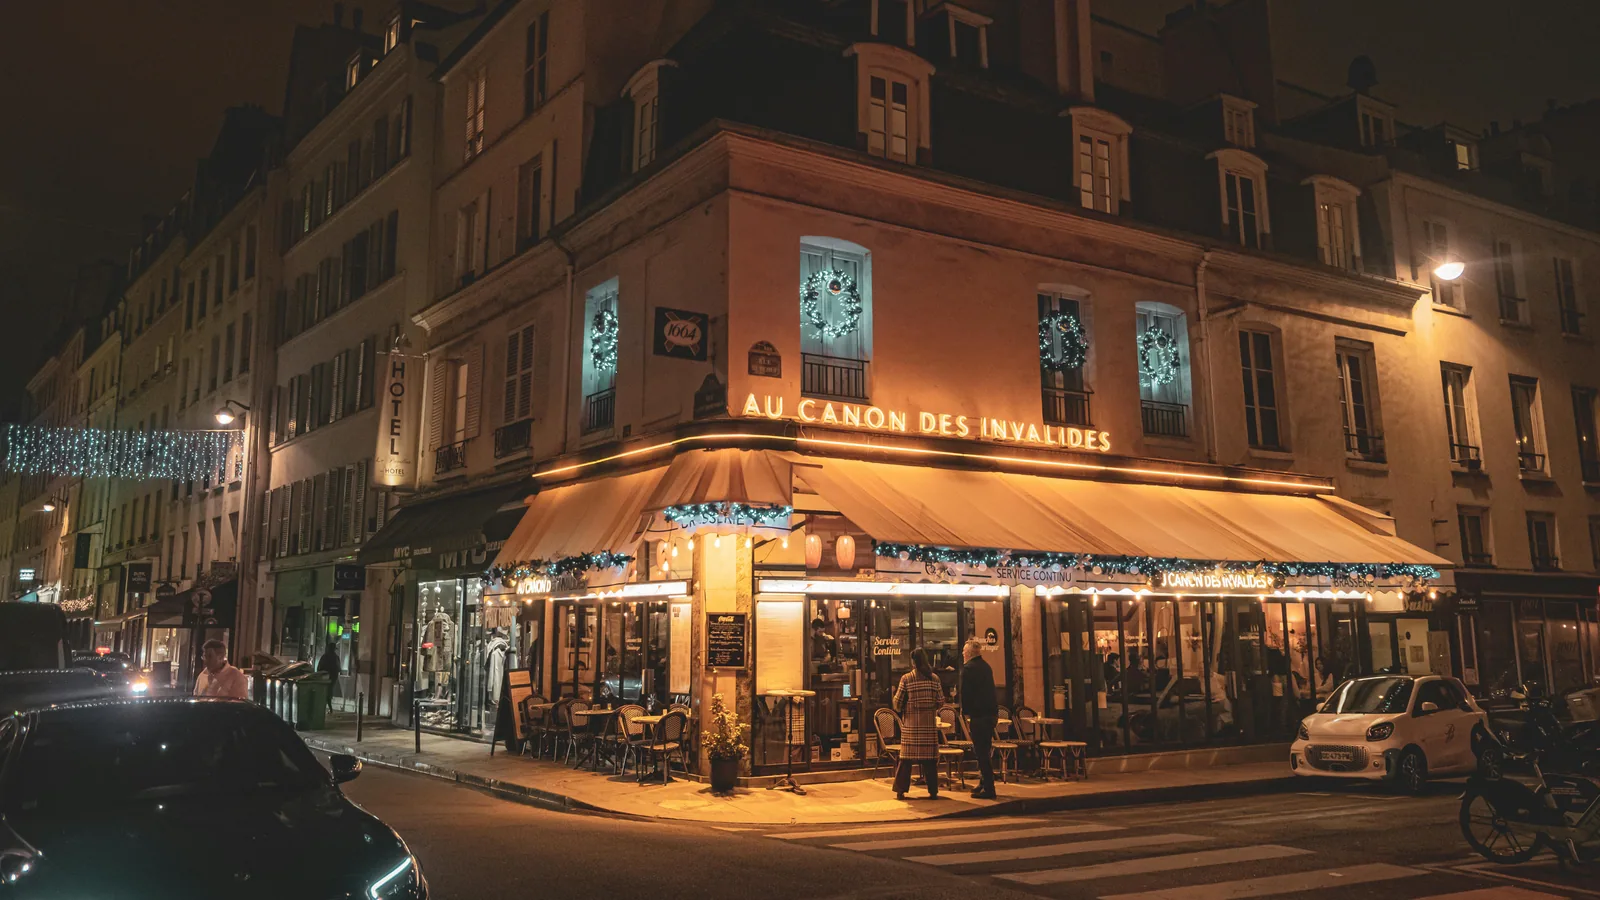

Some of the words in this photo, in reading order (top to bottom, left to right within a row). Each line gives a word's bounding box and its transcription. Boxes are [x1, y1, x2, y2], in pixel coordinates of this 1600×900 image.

[667, 323, 698, 341] 1664
[389, 360, 406, 456] HOTEL
[742, 393, 783, 420] AU
[798, 399, 906, 432] CANON
[920, 411, 969, 437] DES
[981, 416, 1111, 452] INVALIDES
[681, 514, 746, 529] BRSSERIE
[393, 546, 411, 558] MYC
[996, 568, 1032, 580] SERVICE
[1033, 570, 1072, 582] CONTINU
[1204, 574, 1221, 588] DES
[1222, 574, 1267, 588] INVALIDES
[1333, 576, 1376, 588] BRASSERIE
[874, 635, 900, 646] Service
[873, 645, 902, 656] Continu
